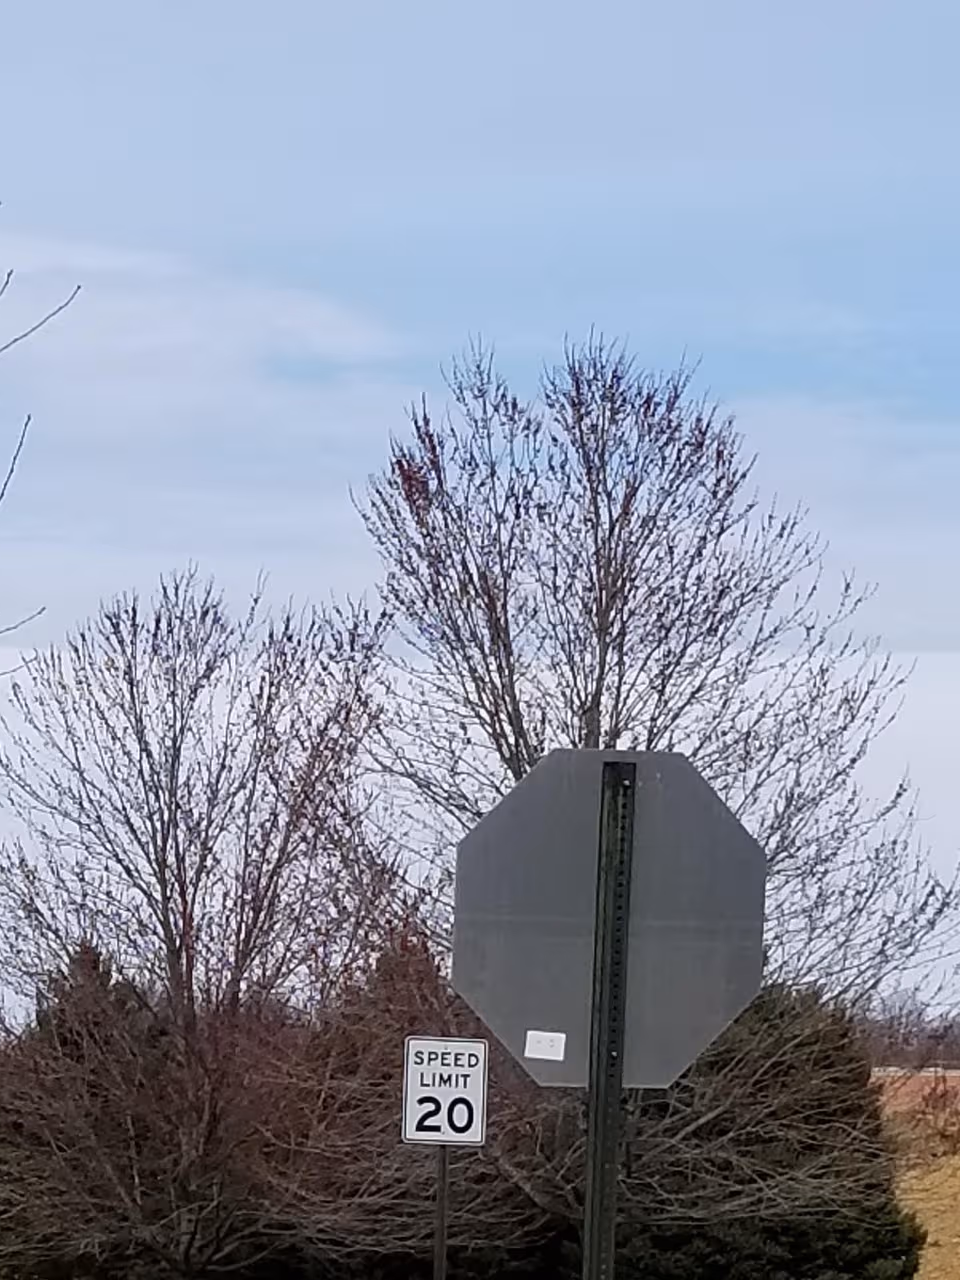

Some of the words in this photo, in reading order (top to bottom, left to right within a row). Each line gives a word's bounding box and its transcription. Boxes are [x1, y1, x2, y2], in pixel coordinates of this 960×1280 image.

[414, 1051, 479, 1068] SPEED
[420, 1073, 471, 1089] LIMIT
[415, 1096, 474, 1133] 20
